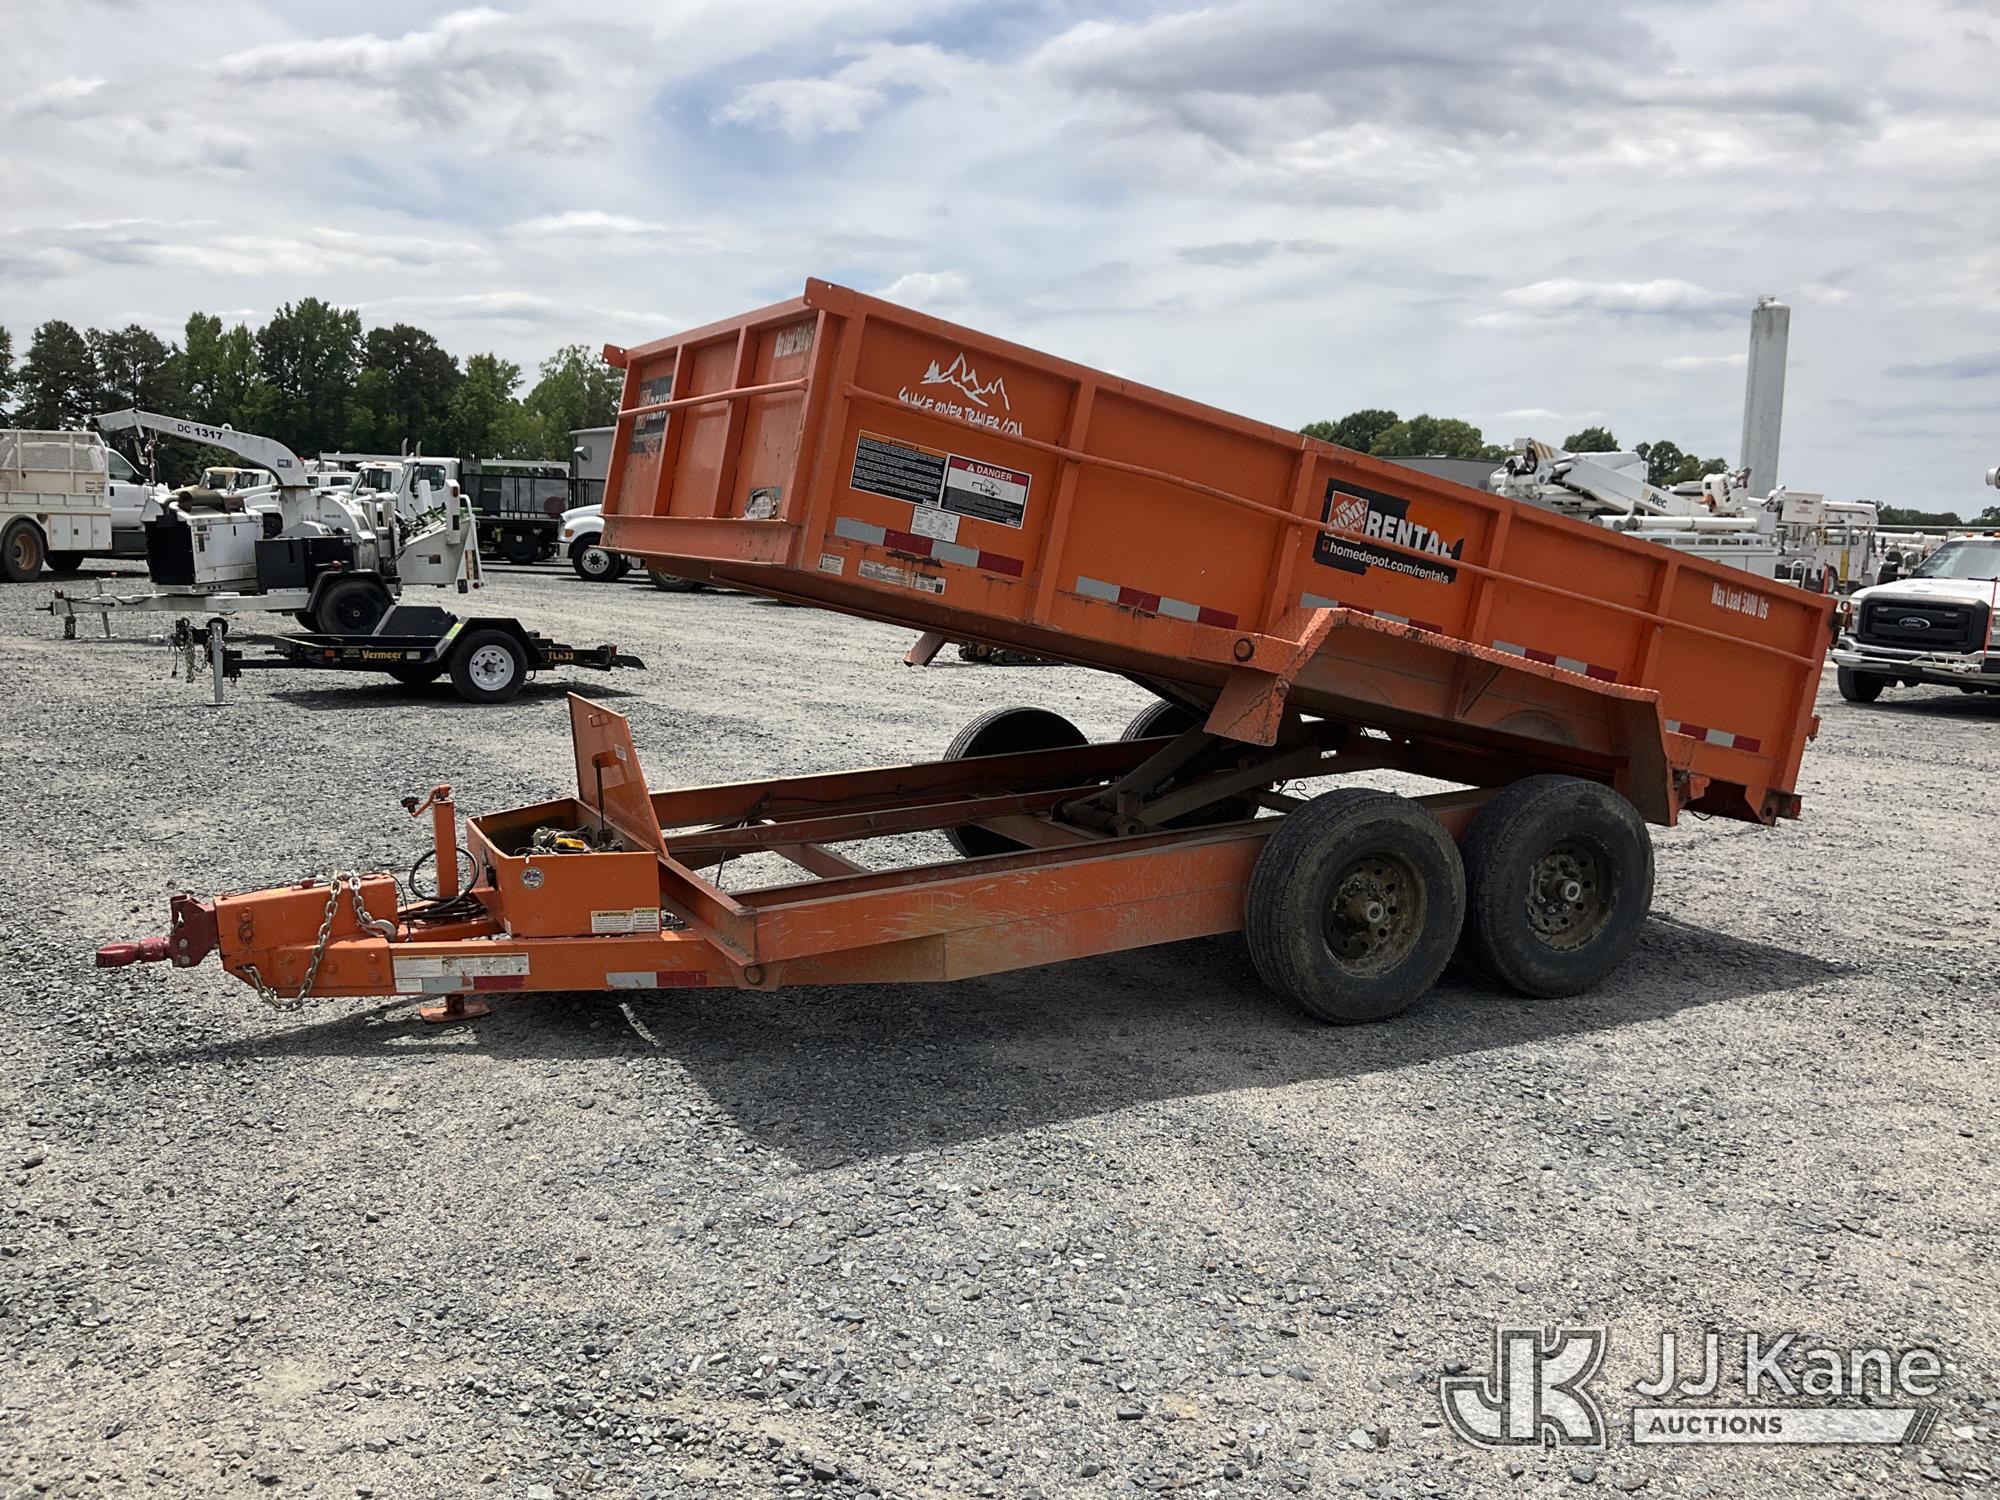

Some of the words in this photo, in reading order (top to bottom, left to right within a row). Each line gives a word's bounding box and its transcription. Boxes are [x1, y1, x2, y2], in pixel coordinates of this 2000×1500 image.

[177, 423, 191, 434] DC
[194, 427, 223, 440] 1317
[976, 465, 1012, 481] DANGER
[1648, 492, 1667, 508] Altec
[1329, 500, 1368, 530] HOME
[1365, 510, 1452, 560] RENTAL
[1329, 541, 1449, 584] homedepot.com/rentals
[362, 650, 402, 659] Vermeer
